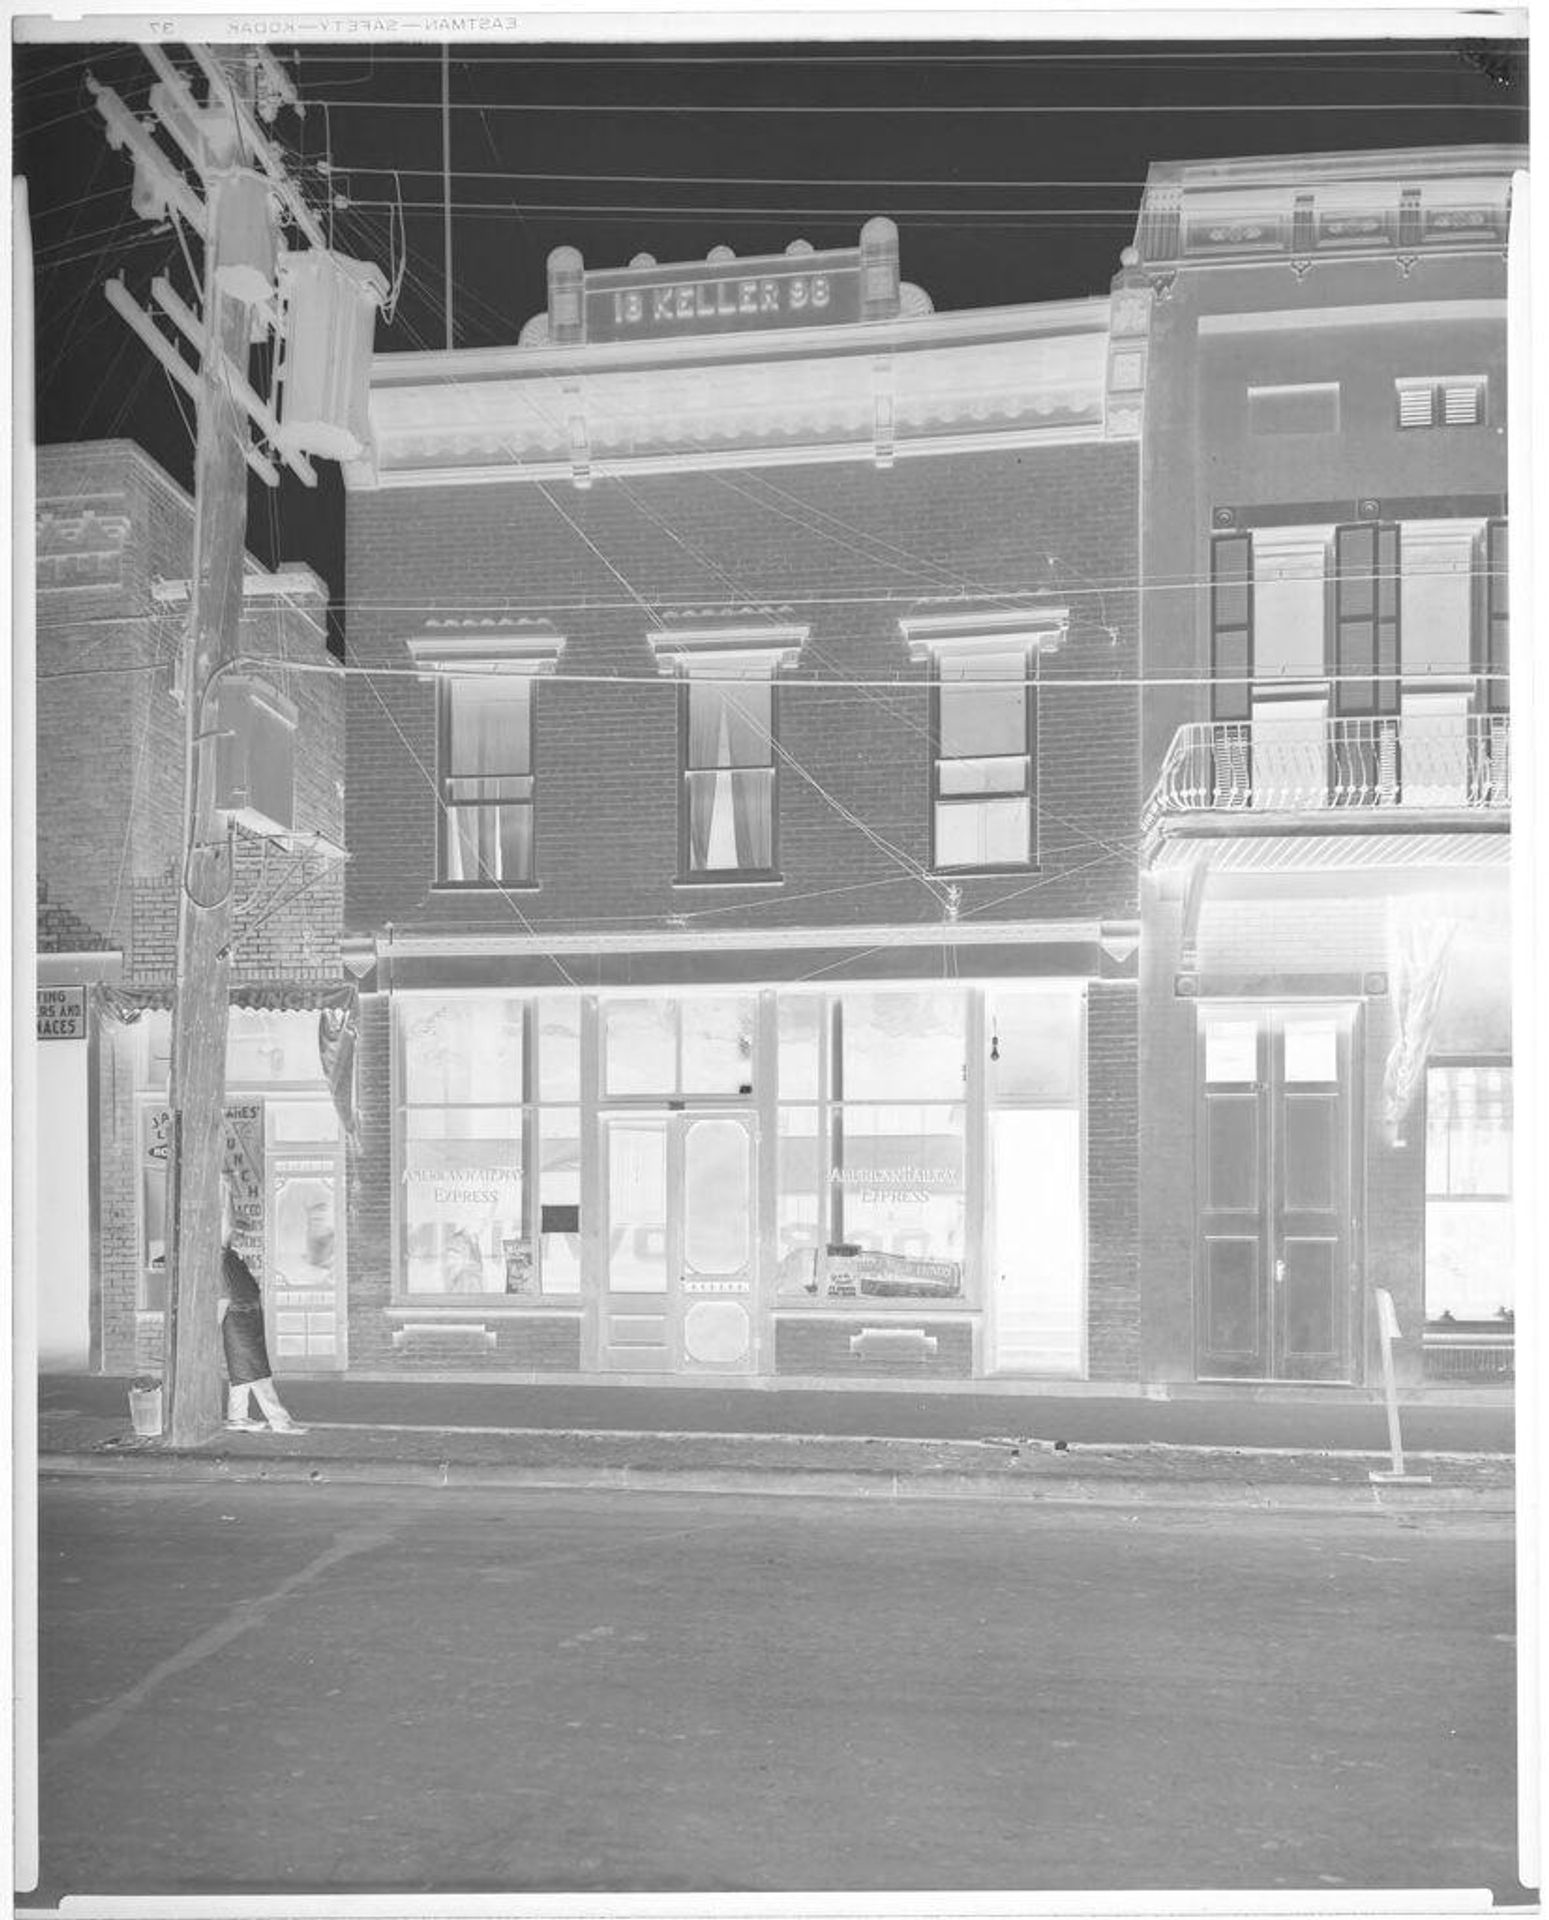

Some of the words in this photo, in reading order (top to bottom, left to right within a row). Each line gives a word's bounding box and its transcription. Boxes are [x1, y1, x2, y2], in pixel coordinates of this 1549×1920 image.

[615, 291, 642, 323] 18
[653, 278, 780, 320] KELLER
[790, 275, 830, 309] 98
[37, 1005, 55, 1017] RS
[60, 1005, 81, 1017] AND
[435, 1187, 498, 1204] EXPRESS
[861, 1187, 931, 1203] EXPRESS
